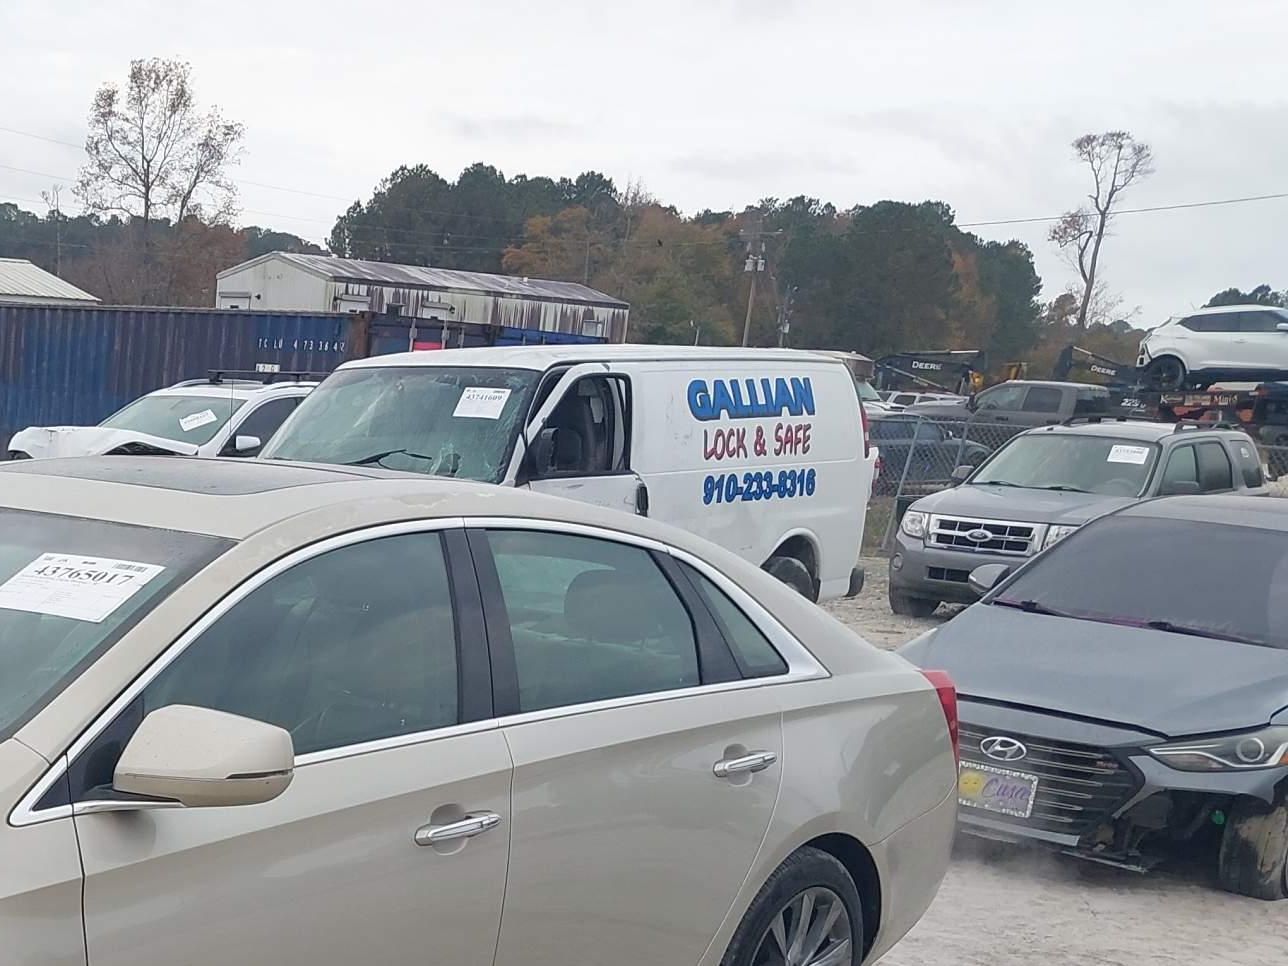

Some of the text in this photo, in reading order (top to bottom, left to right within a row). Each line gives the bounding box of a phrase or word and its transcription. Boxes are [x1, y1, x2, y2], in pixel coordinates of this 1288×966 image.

[912, 360, 943, 371] DEERE
[1090, 365, 1117, 376] DEERE
[687, 377, 815, 421] GALLIAN
[703, 422, 812, 461] LOCK & SAFE
[702, 468, 817, 506] 910-233-8316
[34, 565, 136, 586] 43765017
